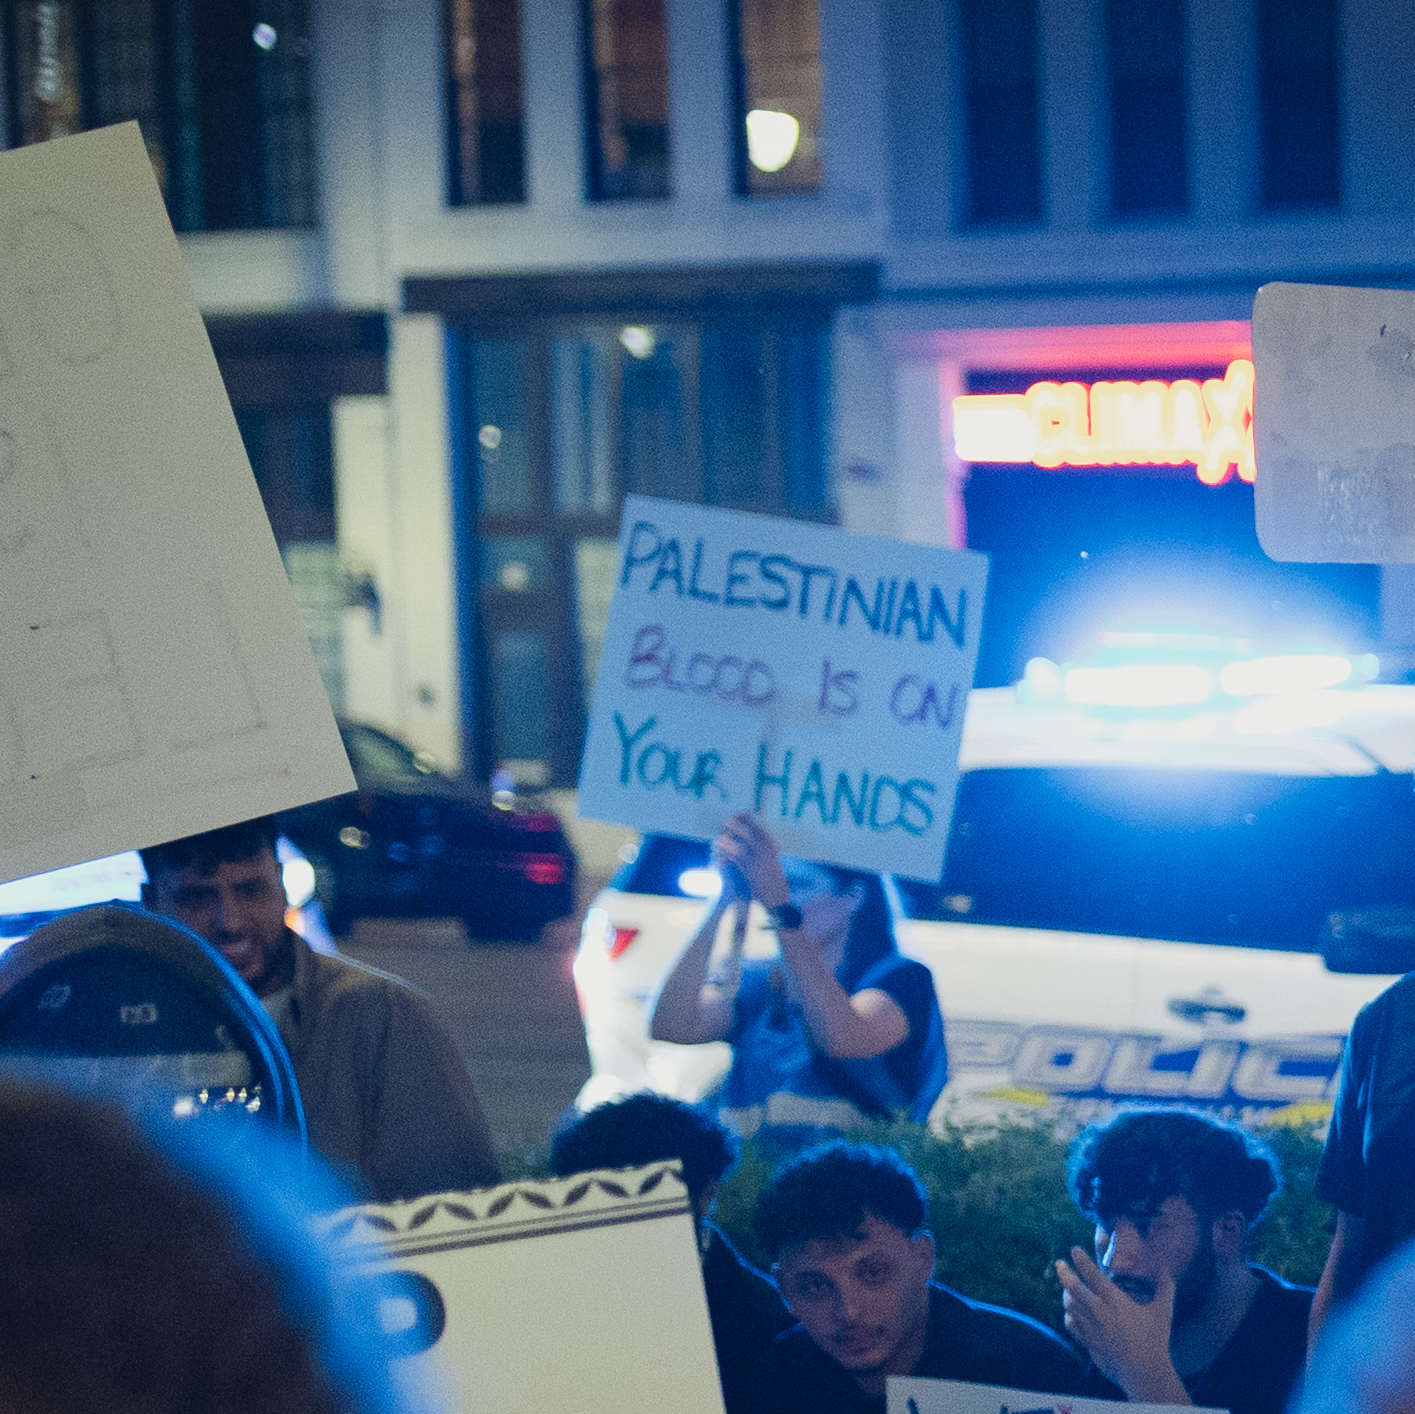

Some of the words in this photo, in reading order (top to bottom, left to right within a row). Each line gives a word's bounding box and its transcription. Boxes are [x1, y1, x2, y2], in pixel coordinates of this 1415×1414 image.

[619, 520, 967, 650] PALESTINIAN
[625, 624, 776, 707] BLOOD
[817, 656, 862, 717] IS
[890, 673, 961, 730] ON
[612, 710, 729, 801] YOUR
[753, 740, 937, 836] HANDS
[946, 1018, 1347, 1102] POLIC
